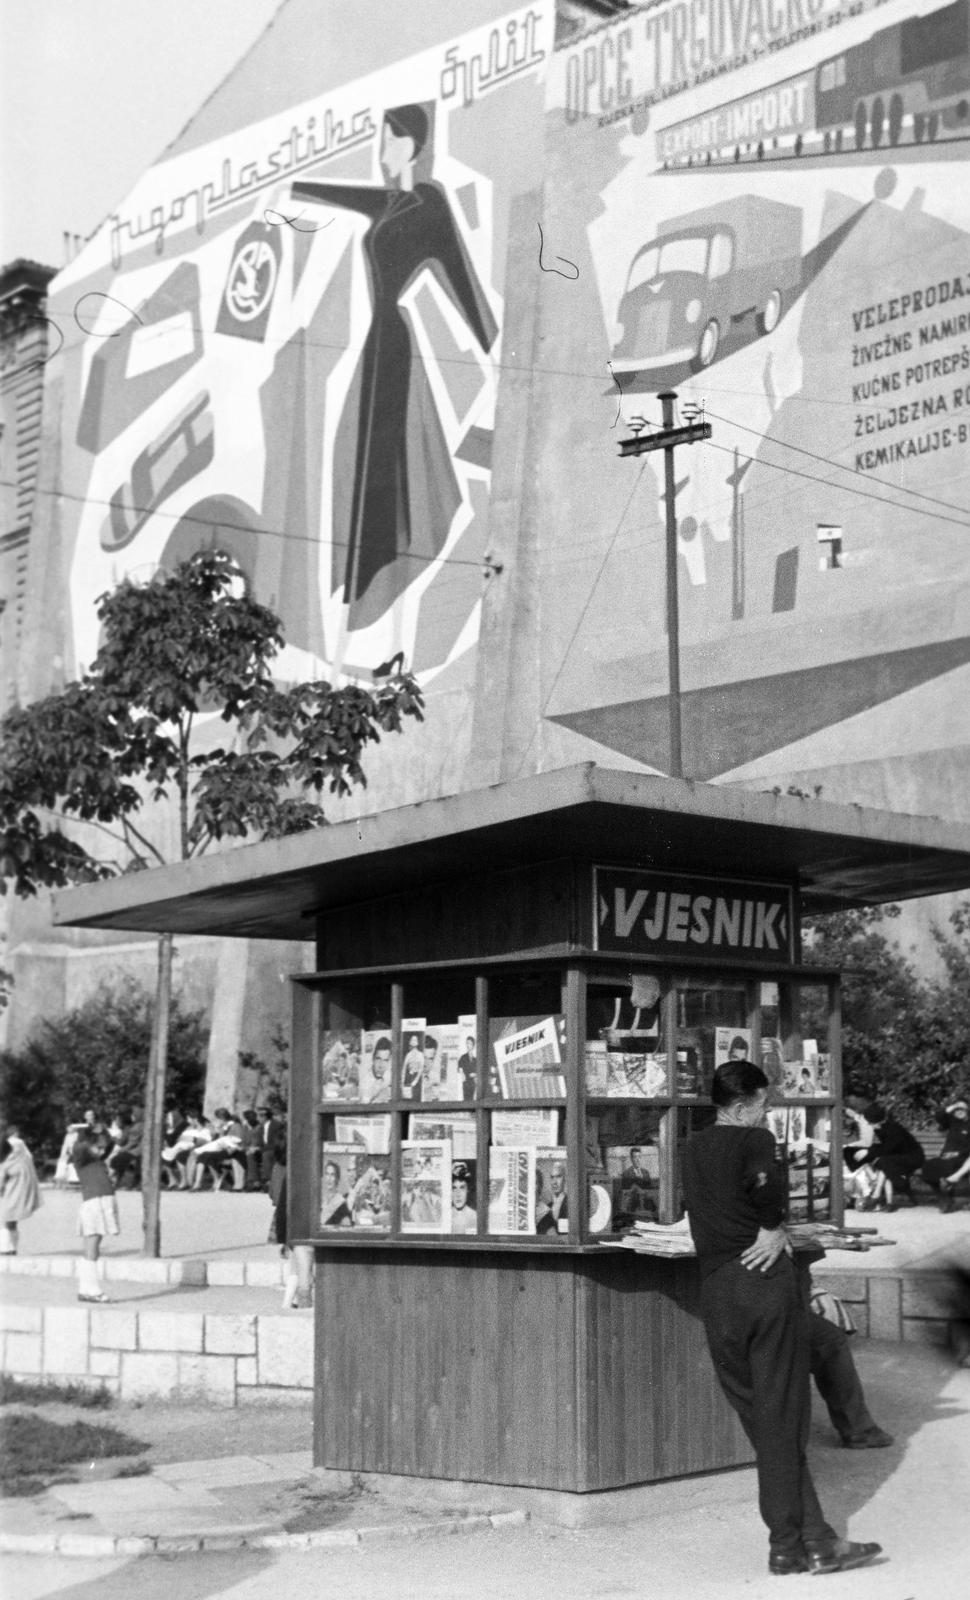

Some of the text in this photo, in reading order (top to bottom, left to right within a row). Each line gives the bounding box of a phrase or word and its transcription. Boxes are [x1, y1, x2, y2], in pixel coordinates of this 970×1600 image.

[851, 332, 912, 367] ŽIVEŽNE
[855, 394, 948, 437] ŽELJEZNA
[614, 887, 782, 951] VJESNIK
[504, 1028, 546, 1055] VJESNIK
